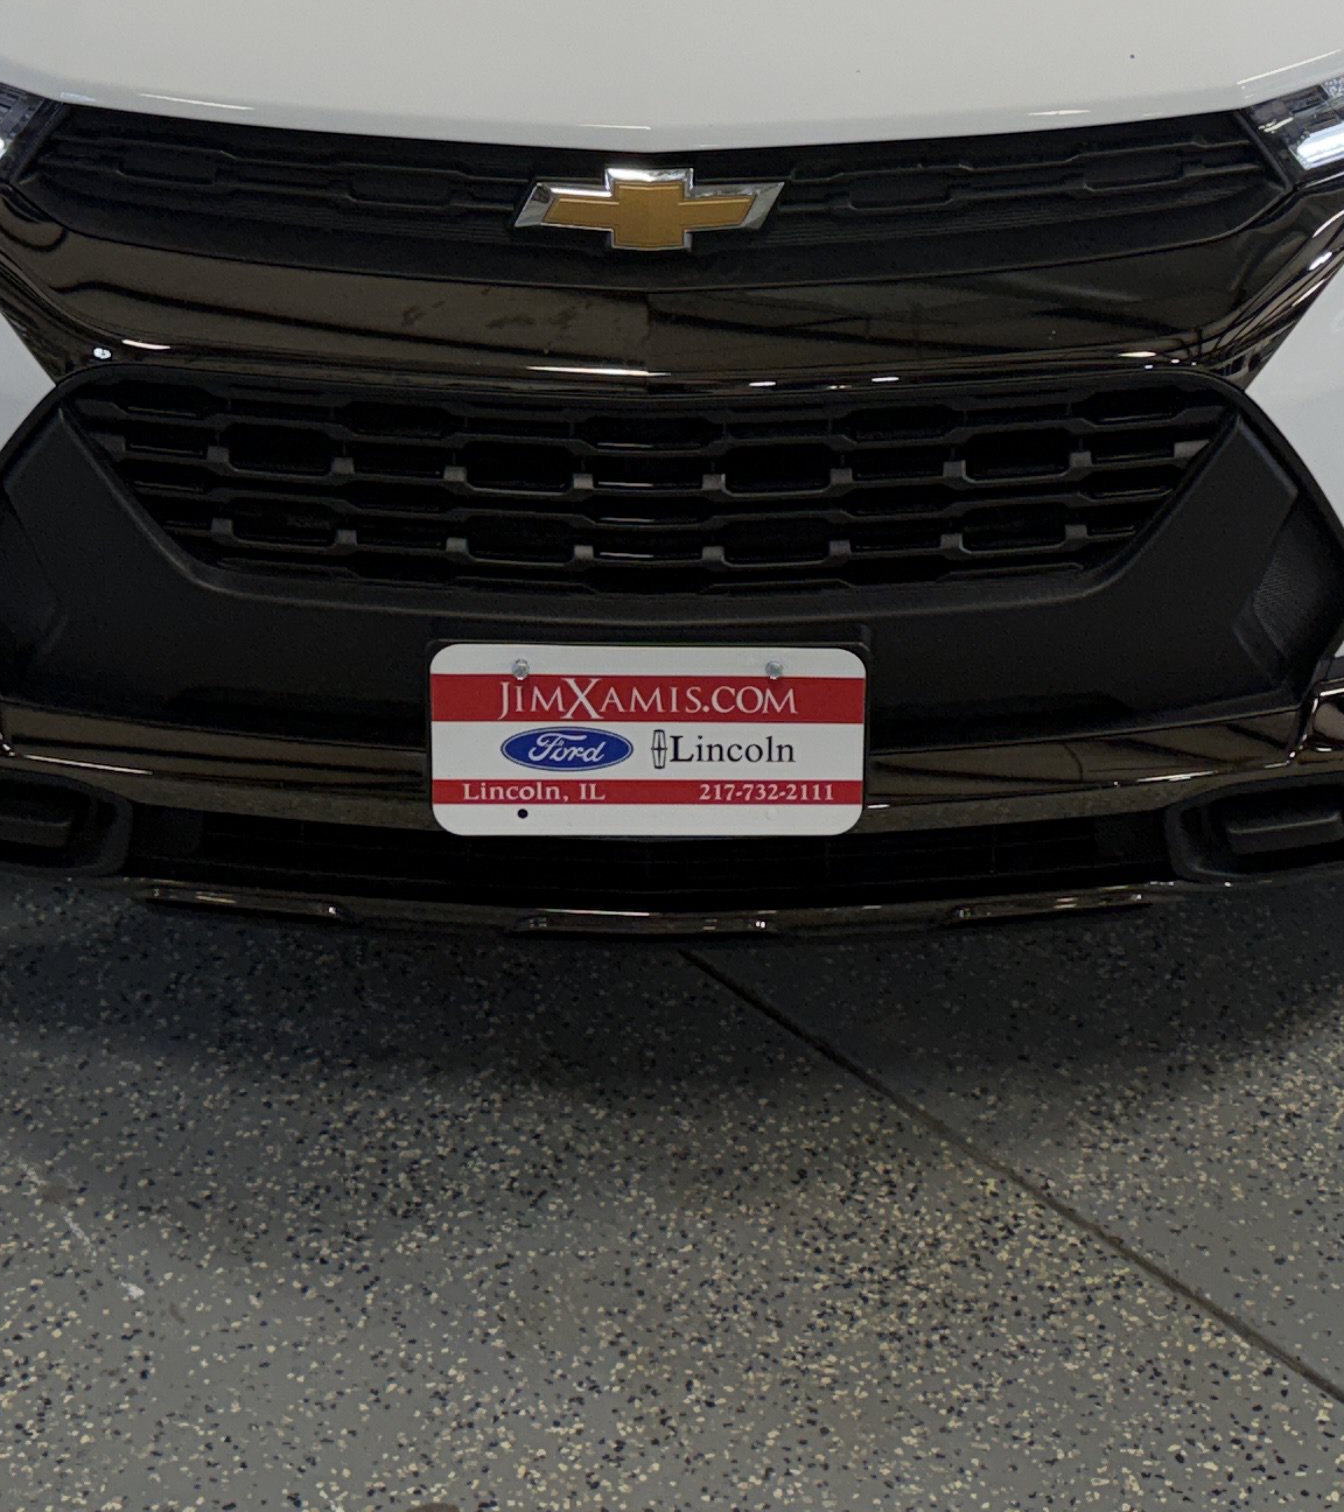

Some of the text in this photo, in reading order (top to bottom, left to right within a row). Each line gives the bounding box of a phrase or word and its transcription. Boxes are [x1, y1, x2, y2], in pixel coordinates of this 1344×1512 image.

[528, 732, 796, 764] Ford Lincoln
[462, 782, 606, 802] Lincoln, IL
[699, 784, 834, 801] 217-732-2111
